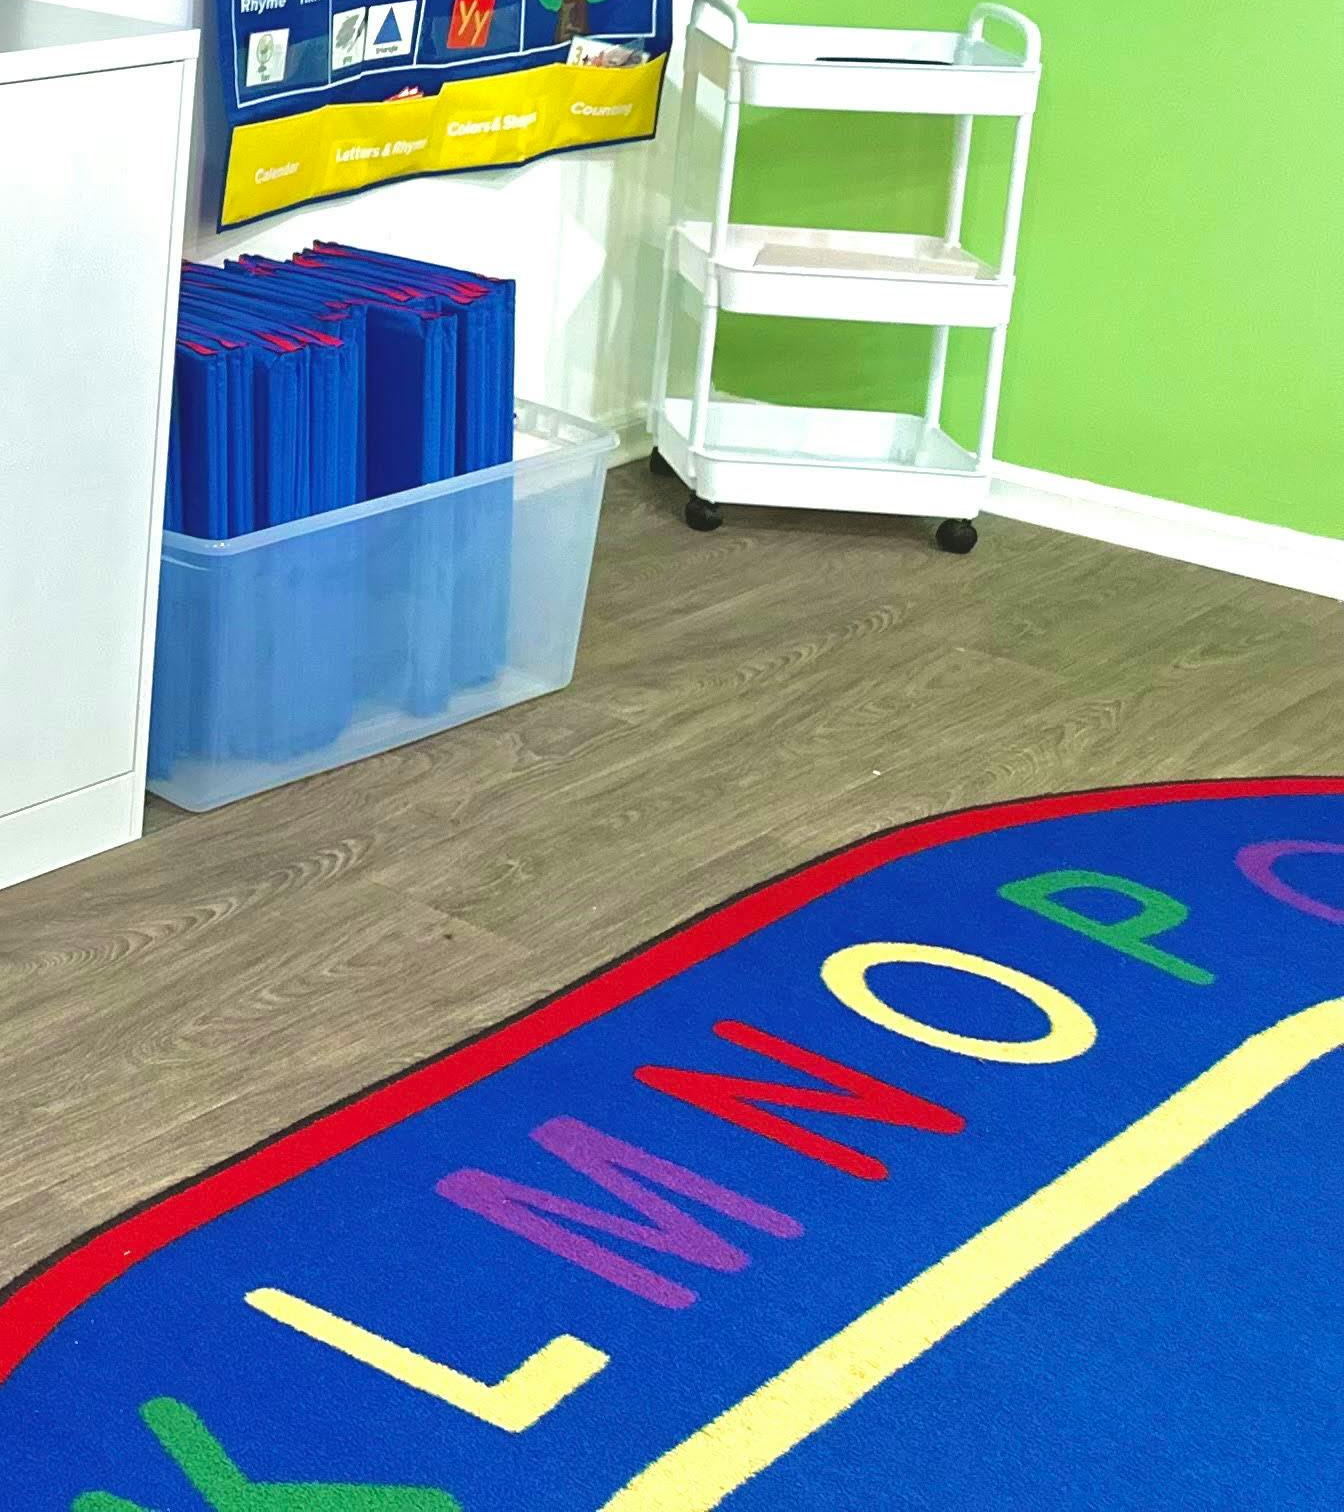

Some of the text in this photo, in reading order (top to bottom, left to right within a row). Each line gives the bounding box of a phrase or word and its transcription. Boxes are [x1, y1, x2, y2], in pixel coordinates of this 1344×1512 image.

[457, 0, 492, 47] Yy
[255, 161, 300, 184] Calendar
[335, 144, 381, 163] Letters
[381, 143, 390, 157] &
[997, 869, 1217, 986] P
[820, 942, 1098, 1065] O
[633, 1019, 967, 1182] N
[435, 1113, 805, 1310] M
[244, 1286, 610, 1433] L
